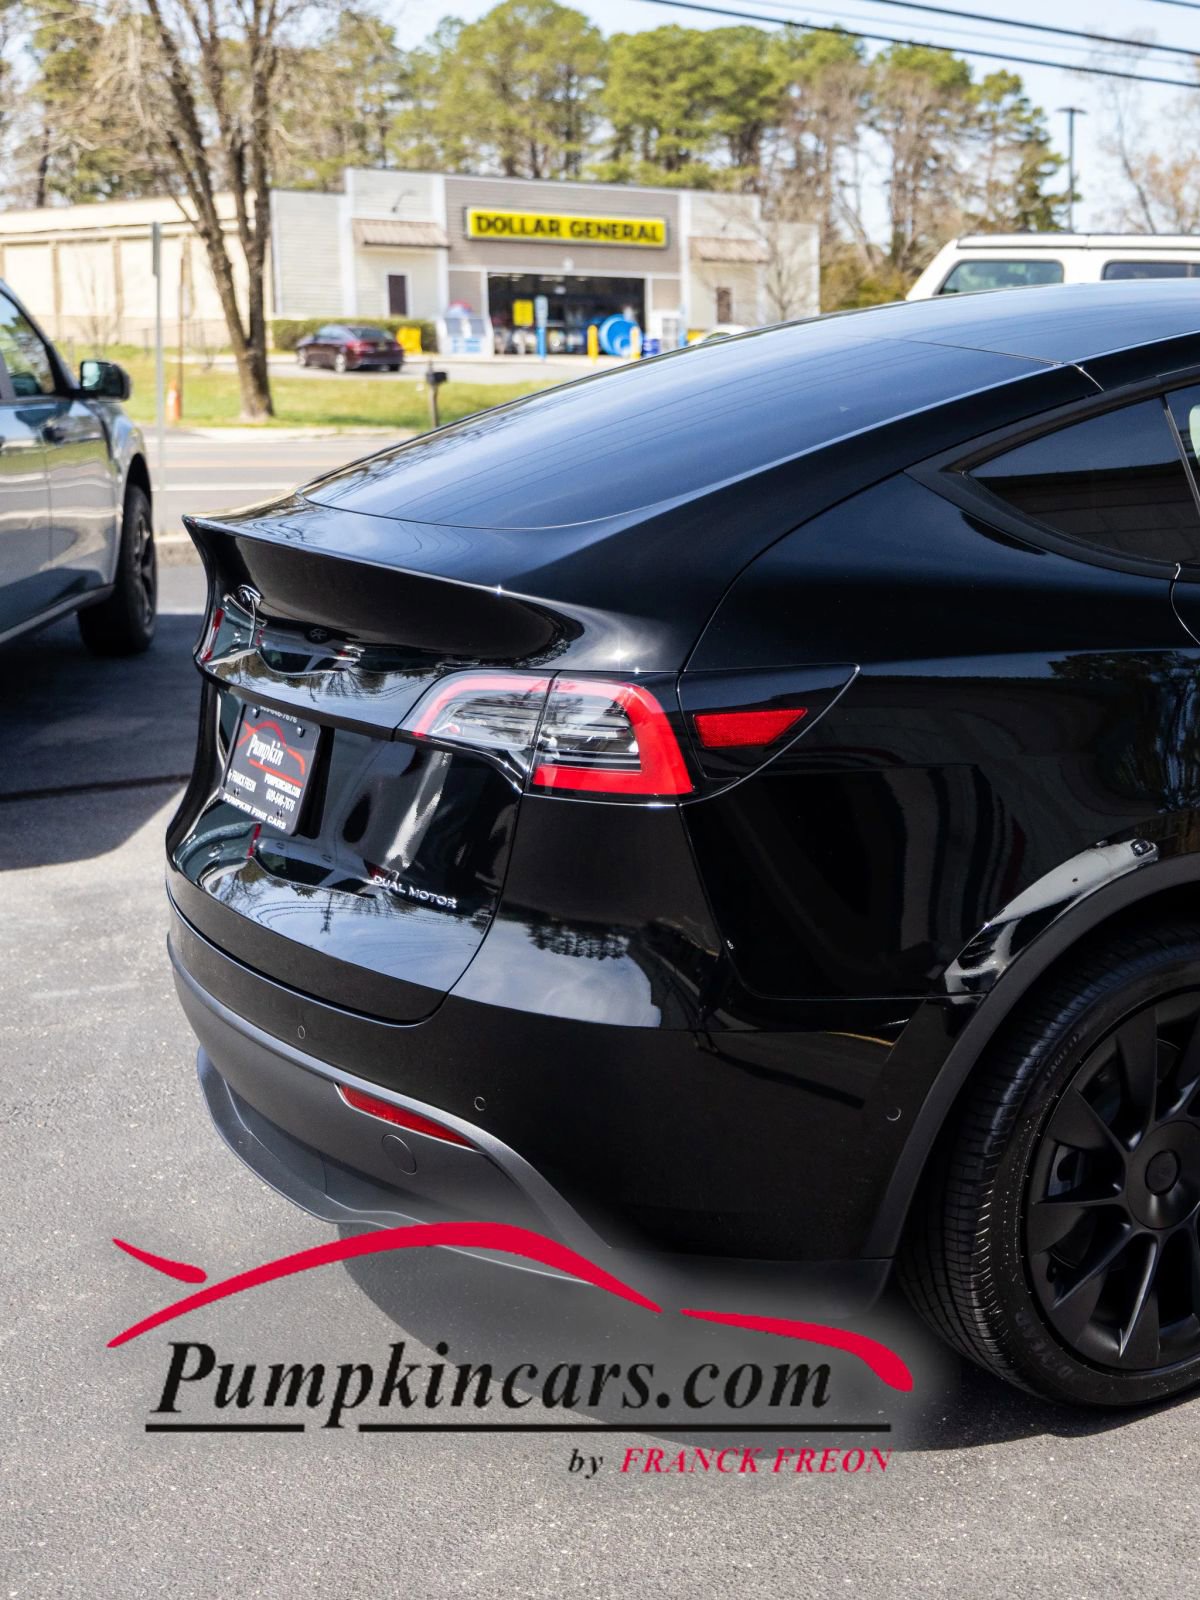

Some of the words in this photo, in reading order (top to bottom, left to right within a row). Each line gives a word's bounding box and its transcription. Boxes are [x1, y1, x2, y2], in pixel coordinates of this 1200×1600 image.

[476, 215, 561, 237] DOLLAR
[569, 220, 662, 243] GENERAL
[246, 734, 285, 766] Pumpkin
[223, 793, 251, 812] PUMPKIN
[251, 807, 267, 821] FINE
[267, 816, 286, 829] CARS
[374, 875, 405, 893] DUAL
[409, 886, 457, 908] MOTOR
